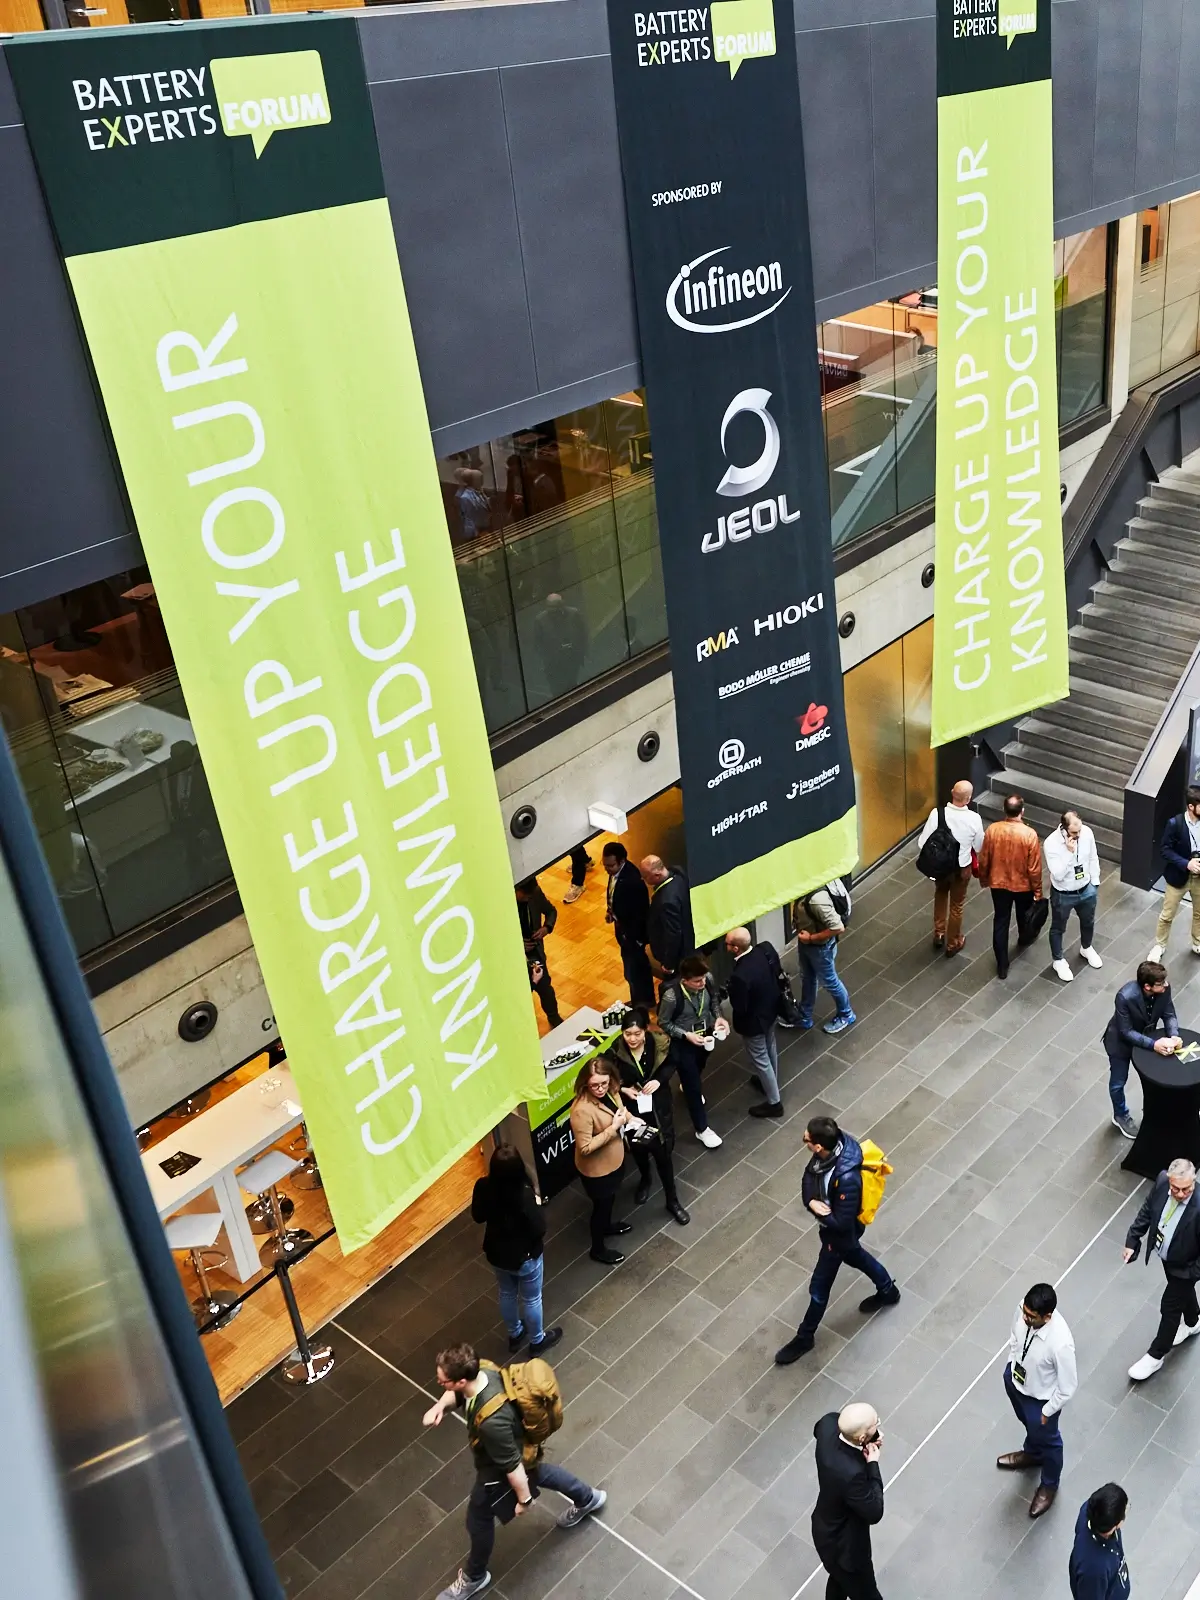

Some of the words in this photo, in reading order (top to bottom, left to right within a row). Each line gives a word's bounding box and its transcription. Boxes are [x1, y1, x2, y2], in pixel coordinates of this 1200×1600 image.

[634, 8, 708, 37] BATTERY
[953, 0, 997, 15] BATTERY
[953, 16, 997, 38] EXPERTS
[1000, 12, 1036, 33] FORUM
[637, 37, 711, 66] EXPERTS
[715, 30, 774, 58] FORUM
[72, 67, 206, 111] BATTERY
[83, 105, 217, 150] EXPERTS
[223, 93, 328, 131] FORUM
[651, 183, 710, 207] SPONSORED
[710, 181, 722, 195] BY
[956, 139, 988, 340] YOUR
[955, 353, 989, 441] UP
[155, 311, 300, 645] YOUR
[1004, 287, 1048, 672] KNOWLEDGE
[701, 494, 801, 553] JEOL
[954, 453, 990, 691] CHARGE
[753, 592, 824, 636] HIOKI
[718, 679, 745, 696] BODO
[745, 664, 779, 686] MÖLLER
[779, 652, 811, 672] CHEMIE
[244, 659, 338, 797] UP
[795, 726, 832, 752] DMEGC
[707, 756, 762, 789] OSTERRATH
[799, 764, 840, 795] jagenberg
[335, 527, 498, 1091] KNOWLEDGE
[283, 800, 422, 1155] CHARGE
